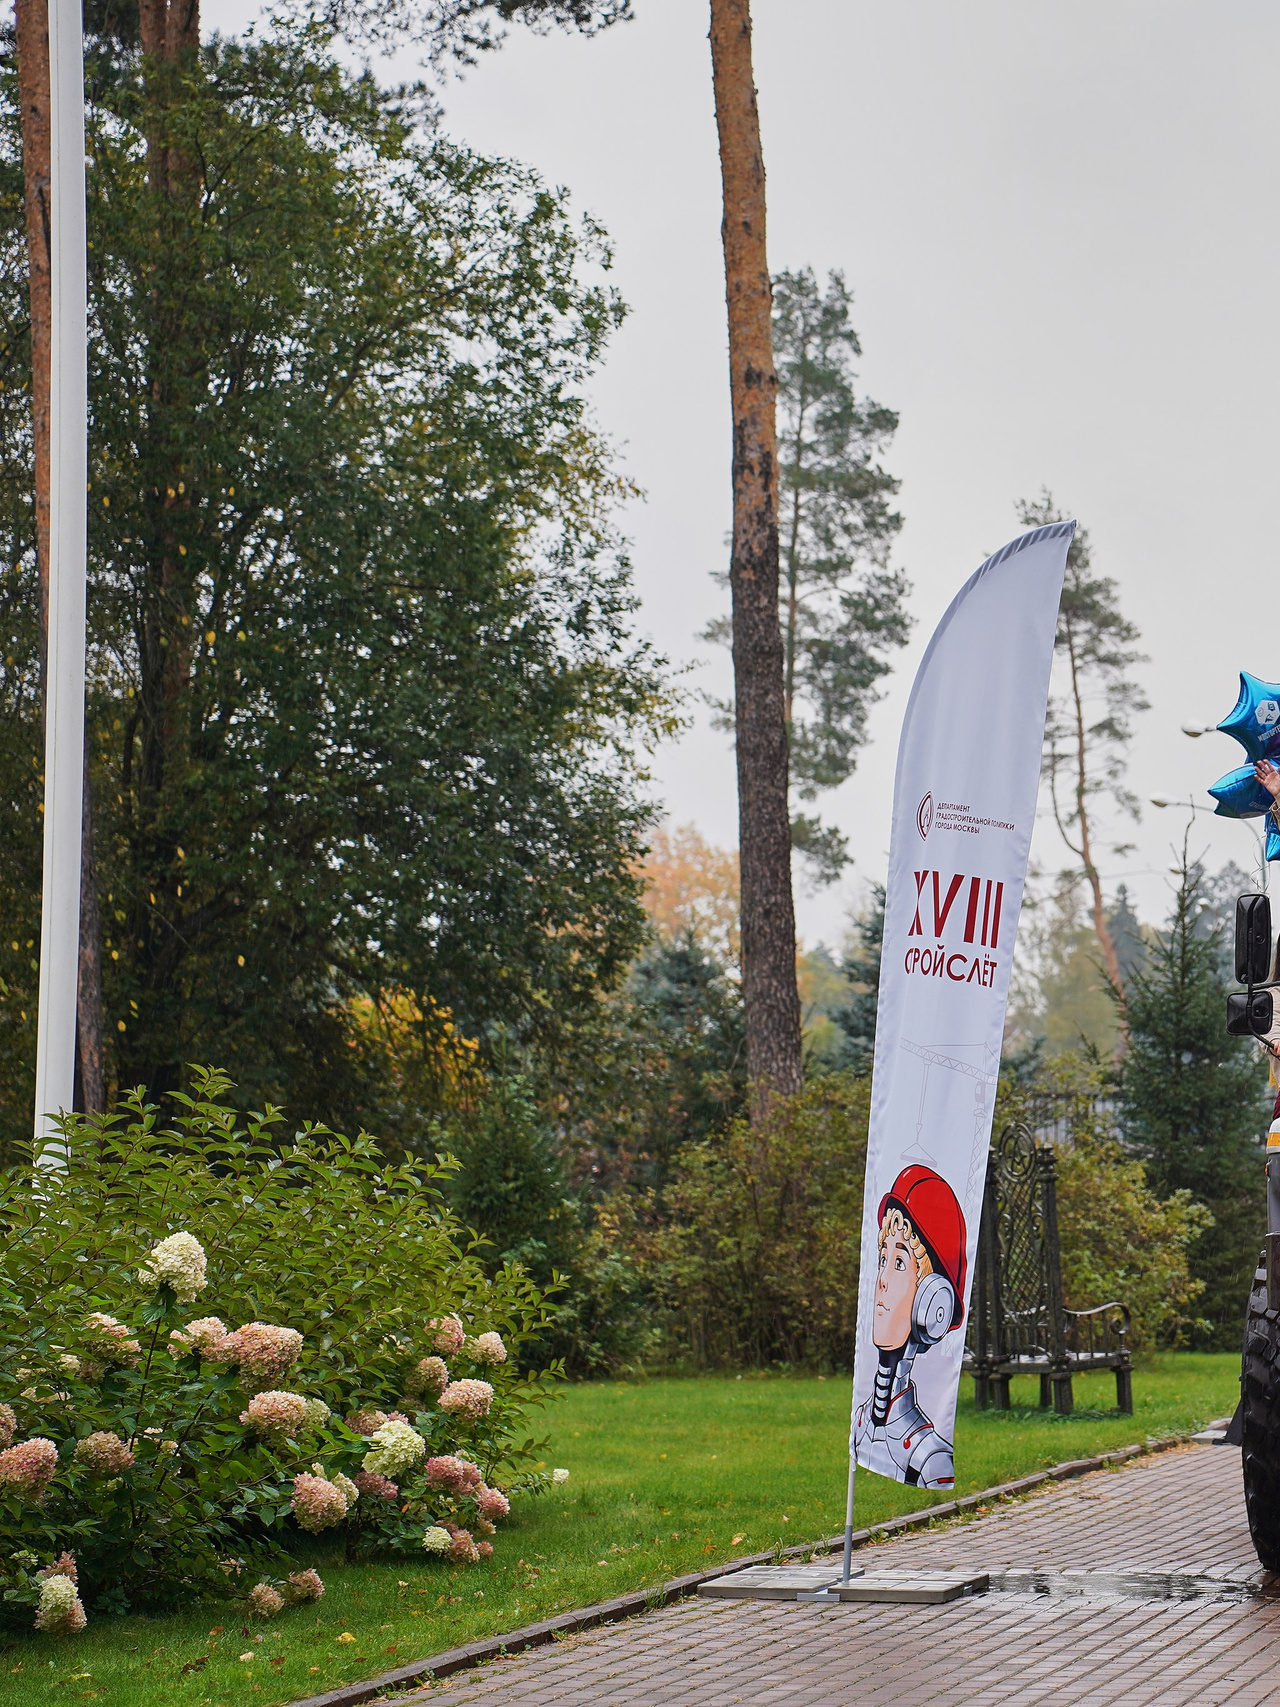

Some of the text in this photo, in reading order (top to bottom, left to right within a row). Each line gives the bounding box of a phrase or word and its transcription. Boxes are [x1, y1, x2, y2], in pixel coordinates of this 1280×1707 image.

[937, 802, 971, 812] ДЕПАРТАМЕНТ
[935, 821, 980, 834] ГОРОДА МОСКВЫ
[936, 812, 1015, 831] ГРАДОСТРОИТЕЛЬНОЙ ПОЛИТИКИ
[908, 870, 1004, 949] XVIII
